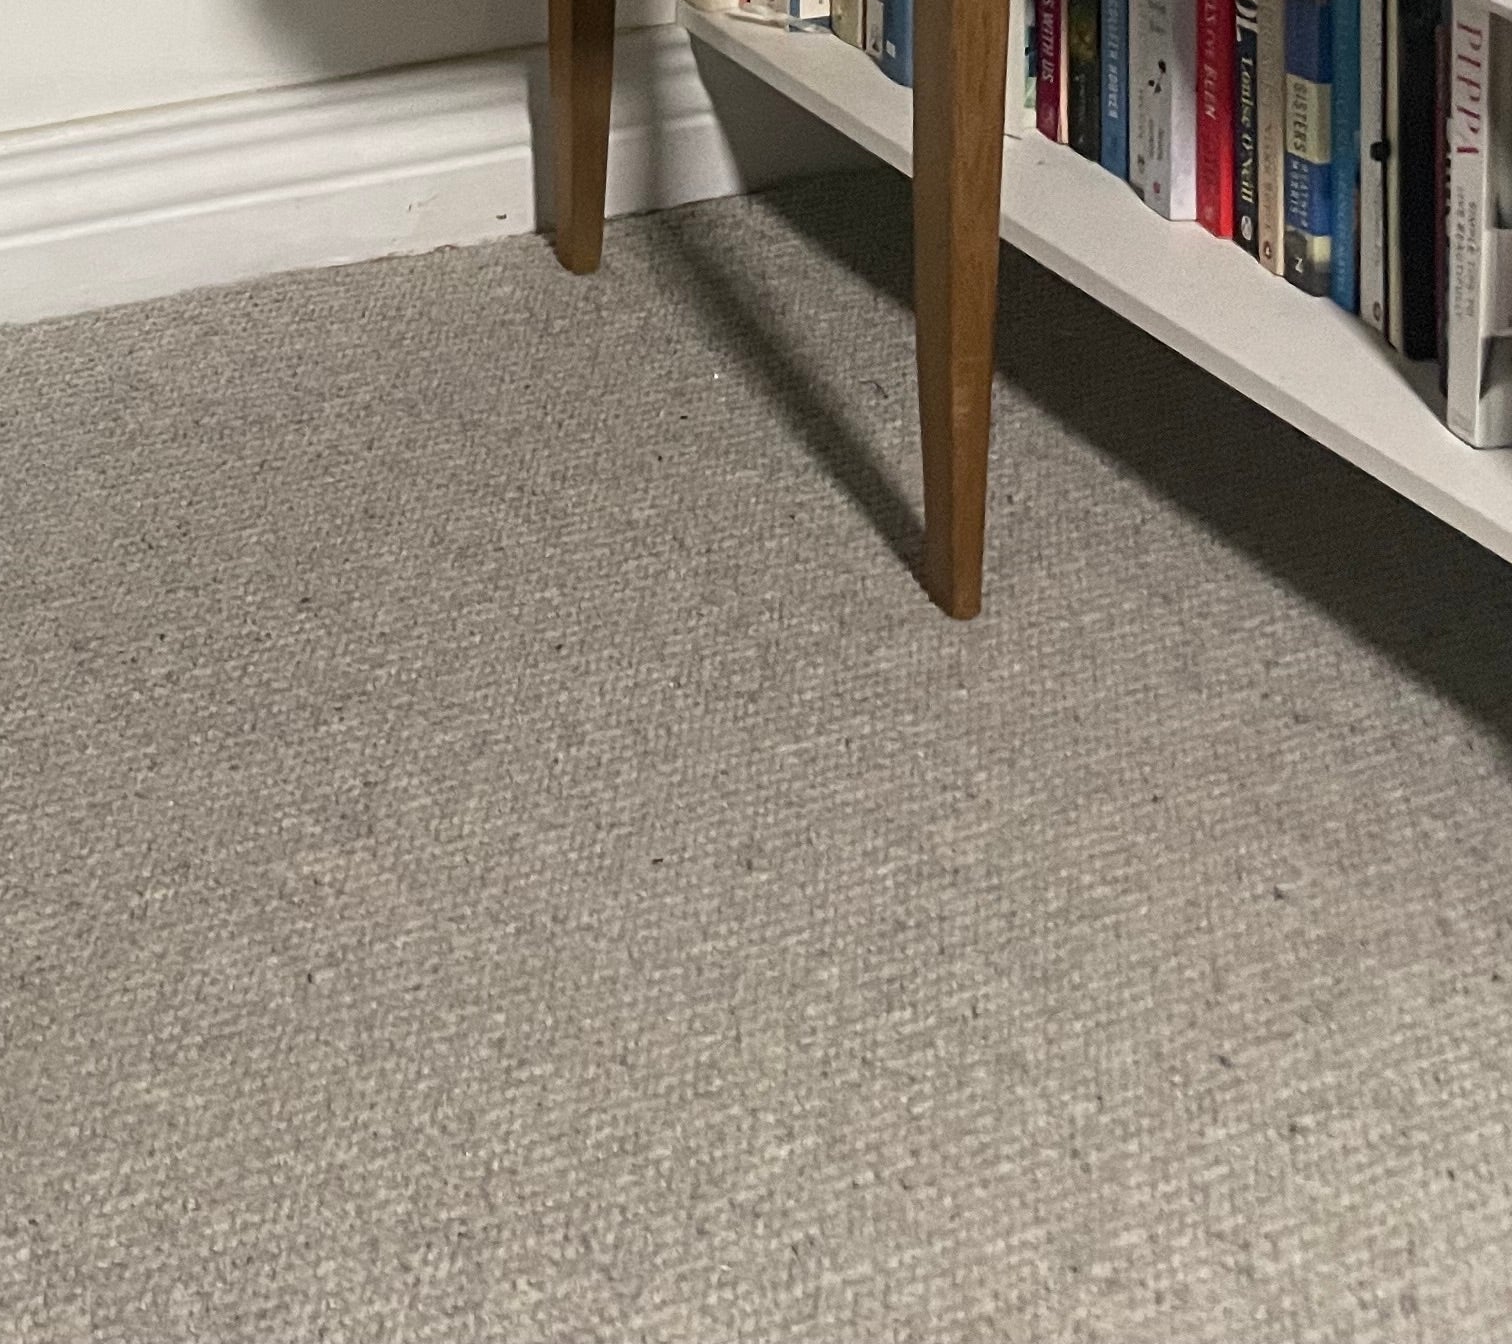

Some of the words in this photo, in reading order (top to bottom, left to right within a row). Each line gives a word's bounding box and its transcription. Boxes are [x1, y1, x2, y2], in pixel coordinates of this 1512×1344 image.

[1042, 12, 1056, 54] WITH
[1041, 58, 1055, 84] US
[1104, 64, 1119, 120] HOOVER
[1240, 56, 1256, 130] Louise
[1455, 19, 1484, 157] PIPPA
[1291, 81, 1308, 154] SISTERS
[1239, 132, 1256, 205] O'Neill
